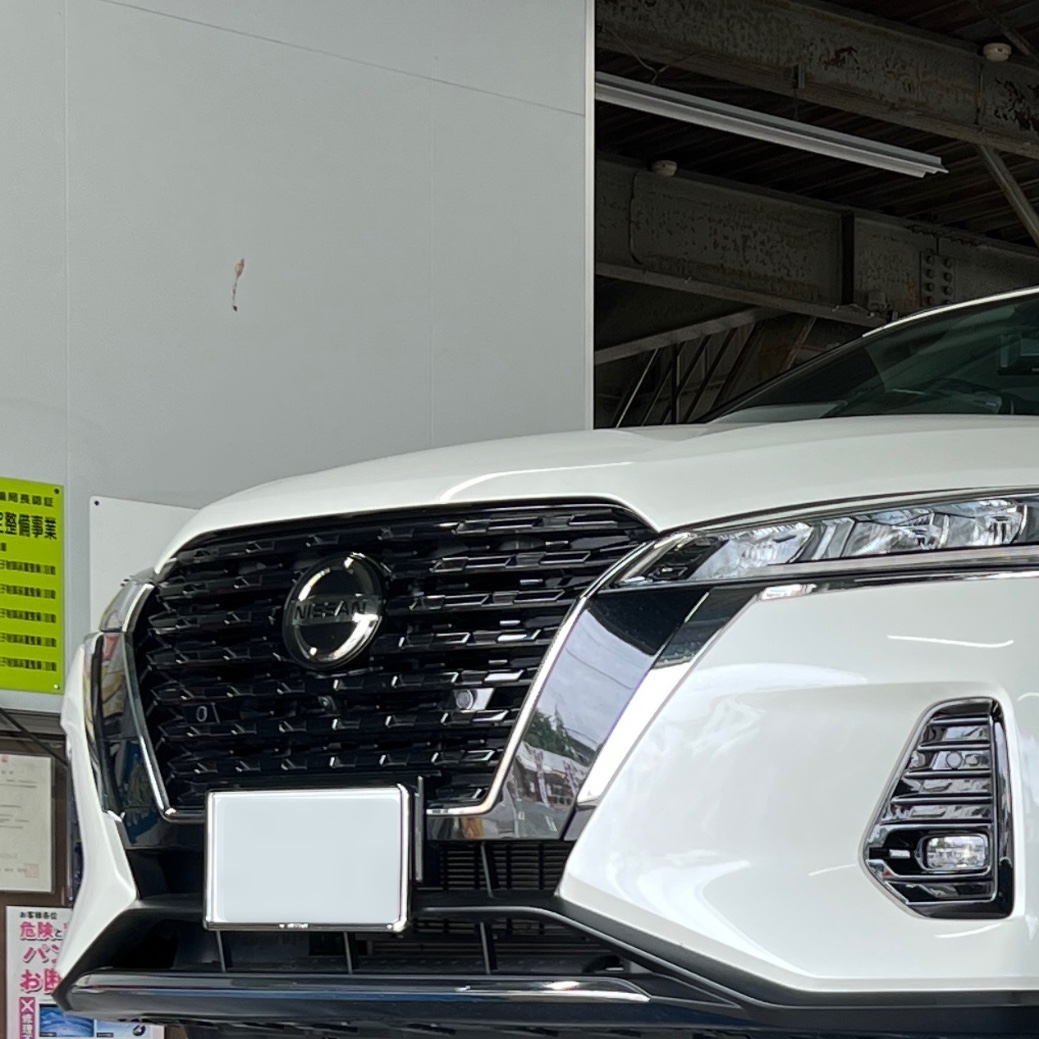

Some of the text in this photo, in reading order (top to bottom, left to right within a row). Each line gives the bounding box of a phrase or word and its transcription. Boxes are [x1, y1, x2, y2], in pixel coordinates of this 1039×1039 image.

[295, 600, 367, 619] NISSAN
[20, 921, 69, 938] 危険と
